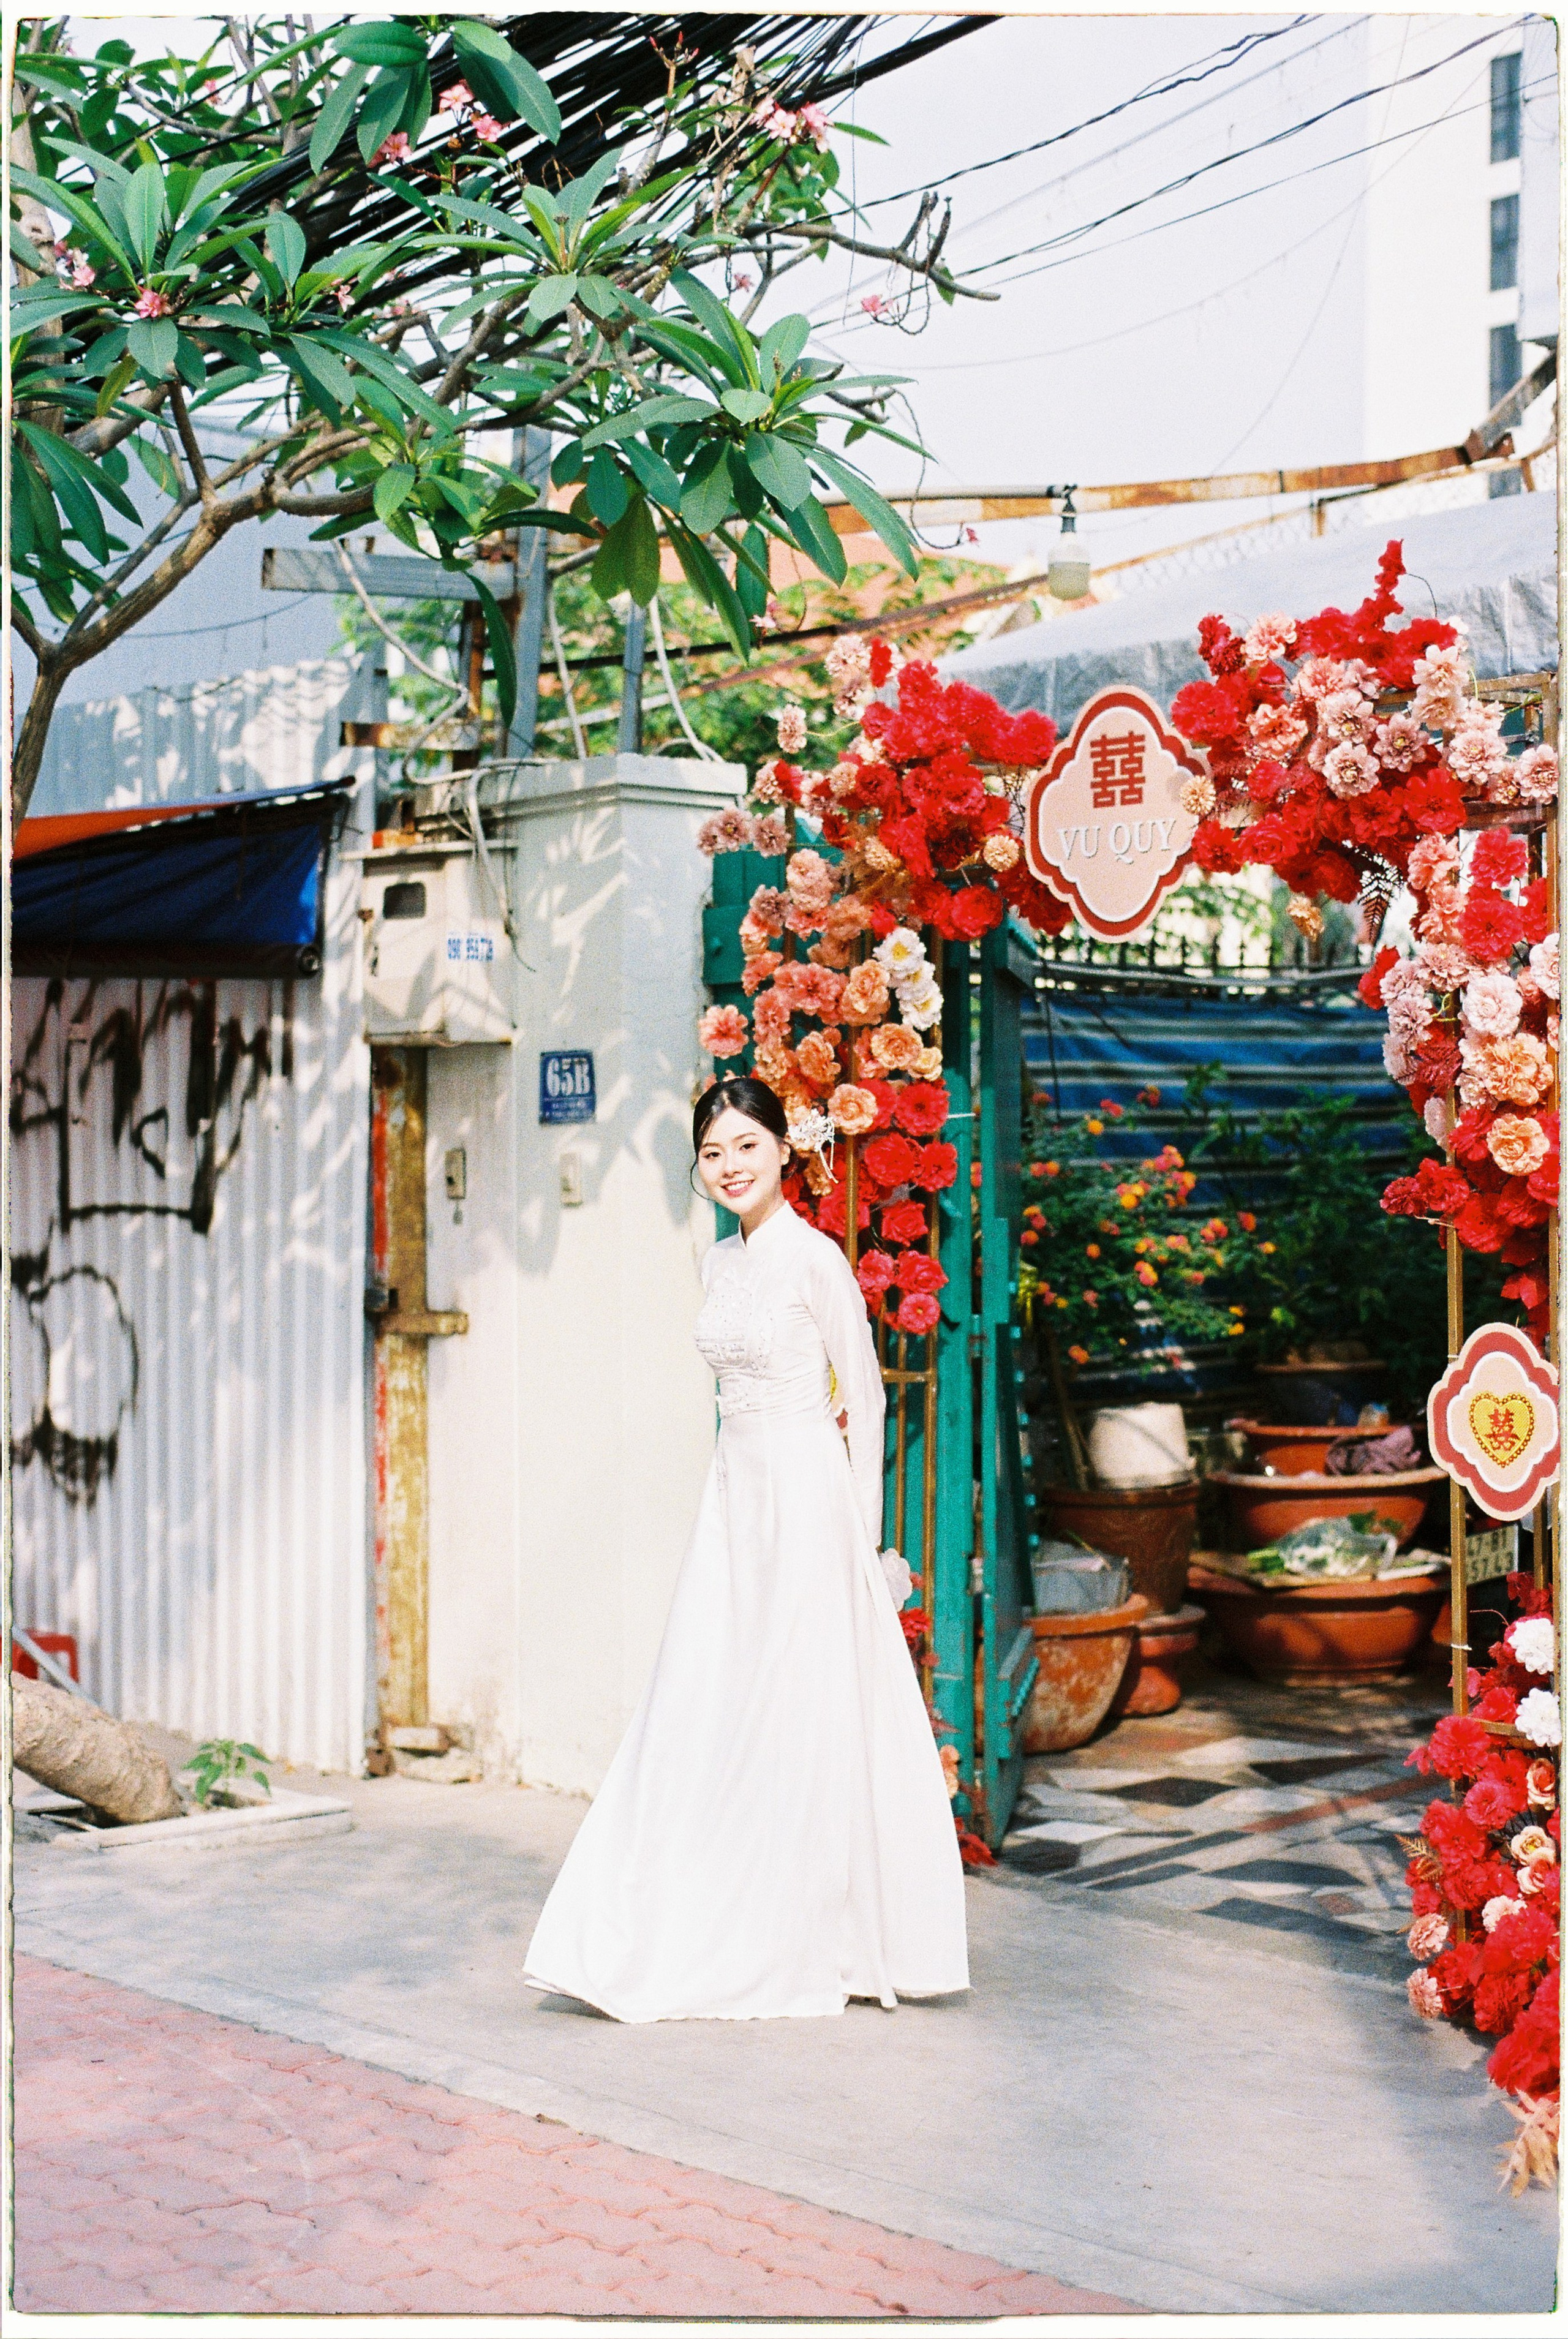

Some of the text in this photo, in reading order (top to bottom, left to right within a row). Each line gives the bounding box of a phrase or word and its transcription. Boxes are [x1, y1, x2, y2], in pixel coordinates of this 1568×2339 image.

[1058, 819, 1176, 864] VU QUY
[546, 1058, 589, 1096] 65B
